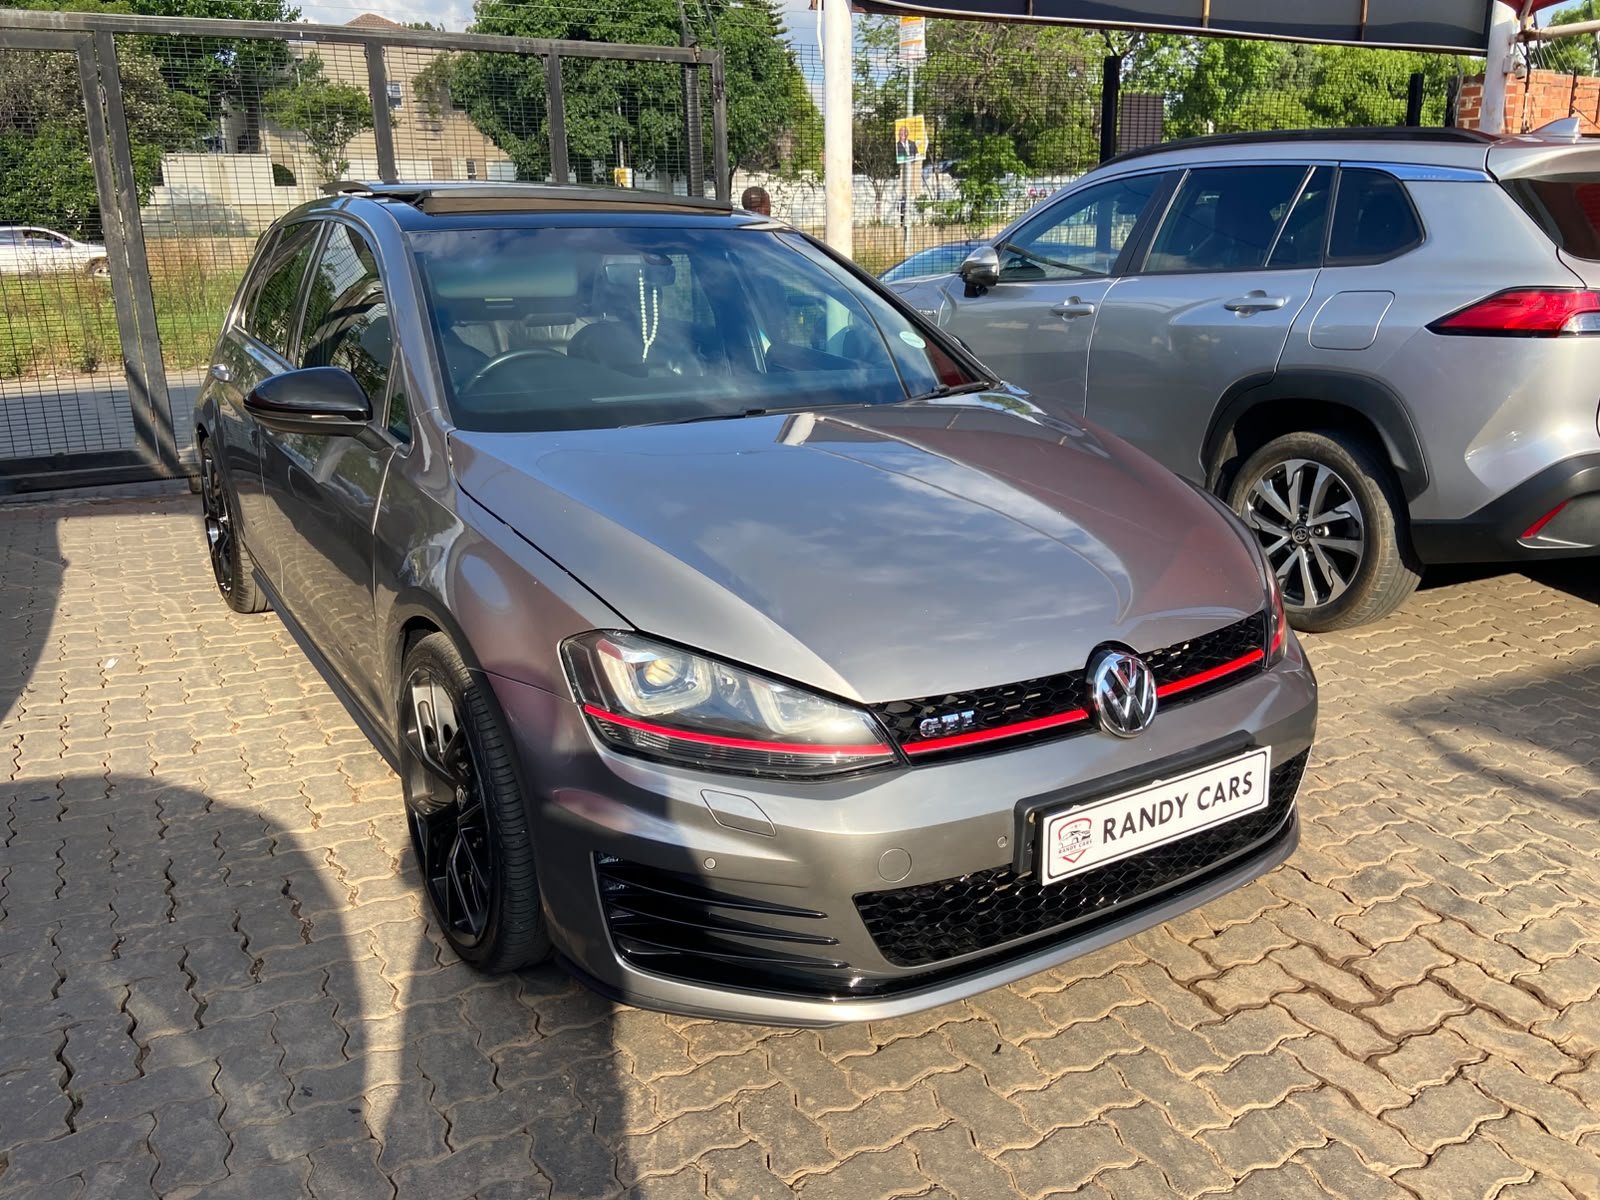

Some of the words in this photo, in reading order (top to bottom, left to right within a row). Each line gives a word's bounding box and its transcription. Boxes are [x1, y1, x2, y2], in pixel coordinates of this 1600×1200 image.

[919, 710, 975, 738] GTI
[1097, 655, 1155, 736] VW
[1102, 793, 1190, 844] RANDY
[1197, 771, 1253, 811] CARS
